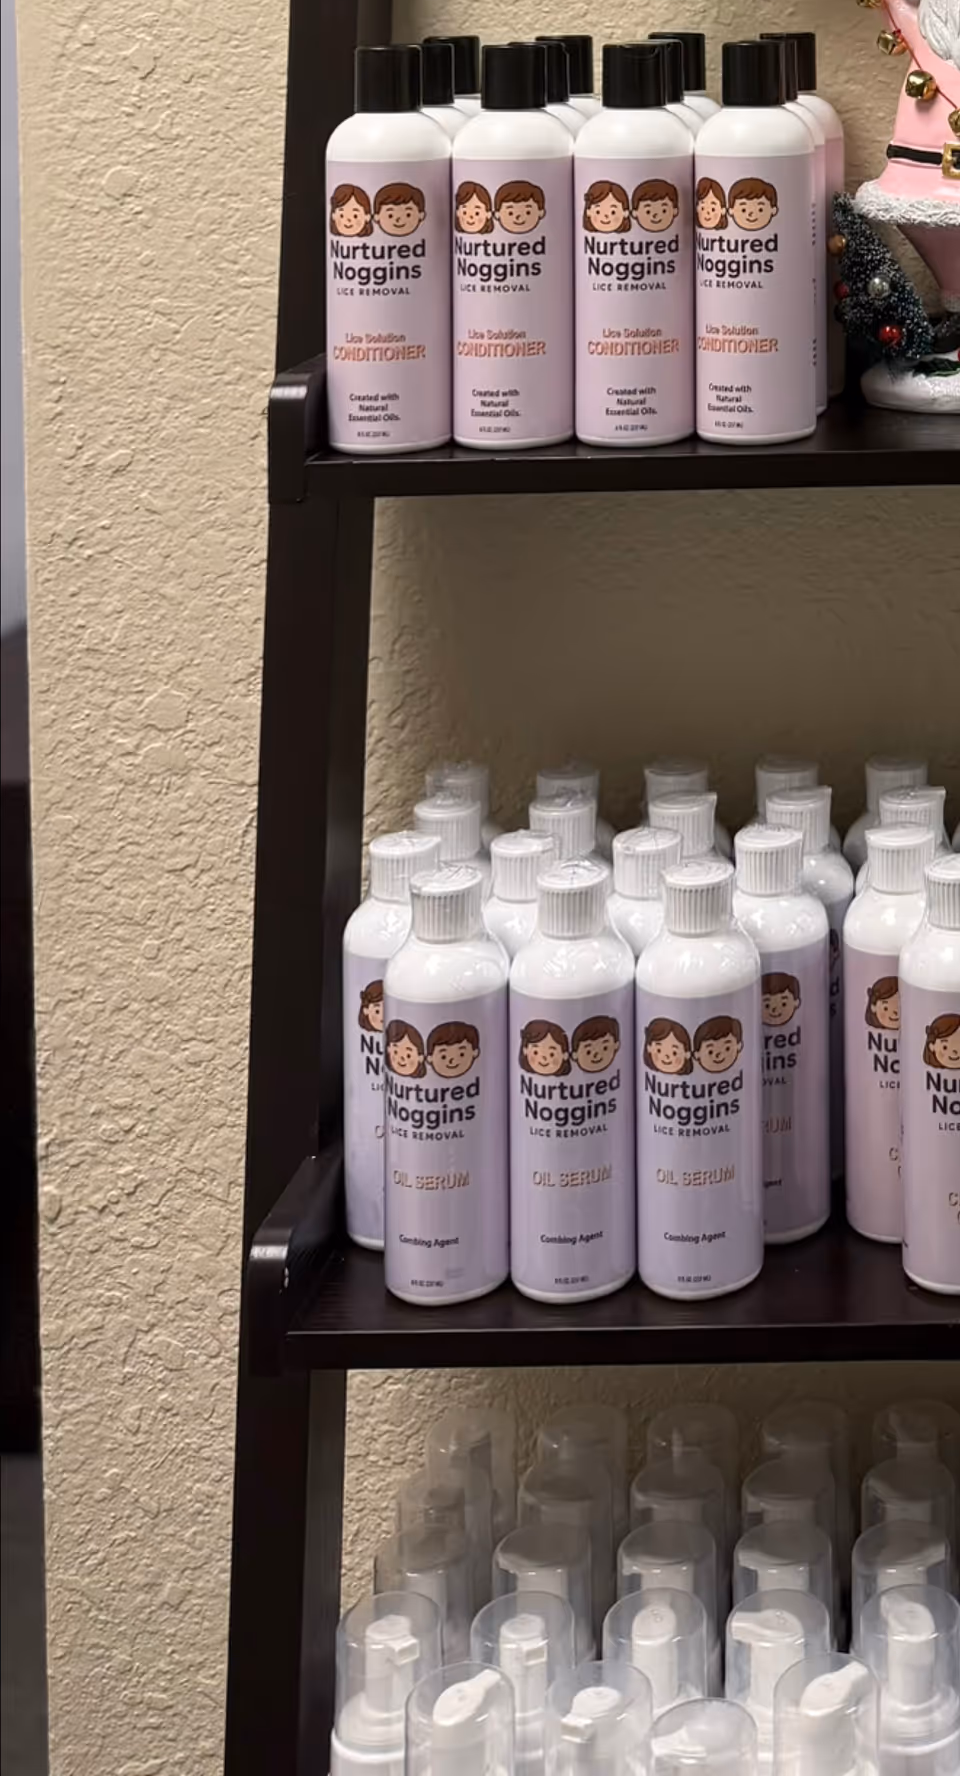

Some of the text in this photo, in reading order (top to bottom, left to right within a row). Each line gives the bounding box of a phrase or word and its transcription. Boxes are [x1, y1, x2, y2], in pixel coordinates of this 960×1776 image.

[330, 239, 426, 260] Nurtured
[455, 236, 546, 257] Nurtured
[584, 234, 679, 255] Nurtured
[333, 262, 422, 285] Noggins
[457, 258, 542, 282] Noggins
[588, 257, 675, 280] Noggins
[697, 253, 774, 278] Noggins
[359, 287, 410, 296] REMOVAL
[480, 284, 530, 293] REMOVAL
[593, 283, 666, 291] LICE REMOVAL
[716, 281, 763, 289] REMOVAL
[345, 333, 363, 343] Lice
[468, 330, 484, 339] Lice
[603, 329, 620, 338] Lice
[333, 345, 426, 362] CONDITIONER
[457, 342, 546, 358] CONDITIONER
[588, 339, 679, 356] CONDITIONER
[607, 387, 656, 396] Created with
[385, 1072, 480, 1103] Nurtured
[520, 1069, 620, 1100] Nurtured
[645, 1071, 743, 1099] Nurtured
[388, 1097, 475, 1130] Noggins
[525, 1097, 616, 1126] Noggins
[649, 1098, 739, 1126] Noggins
[412, 1130, 464, 1140] REMOVAL
[530, 1125, 608, 1138] LICE REMOVAL
[654, 1124, 730, 1136] LICE REMOVAL
[394, 1170, 470, 1190] OIL SERUM
[533, 1164, 612, 1188] OIL SERUM
[656, 1164, 735, 1187] OIL SERUM
[434, 1237, 459, 1247] Agent
[579, 1230, 603, 1243] Agent
[702, 1231, 725, 1242] Agent
